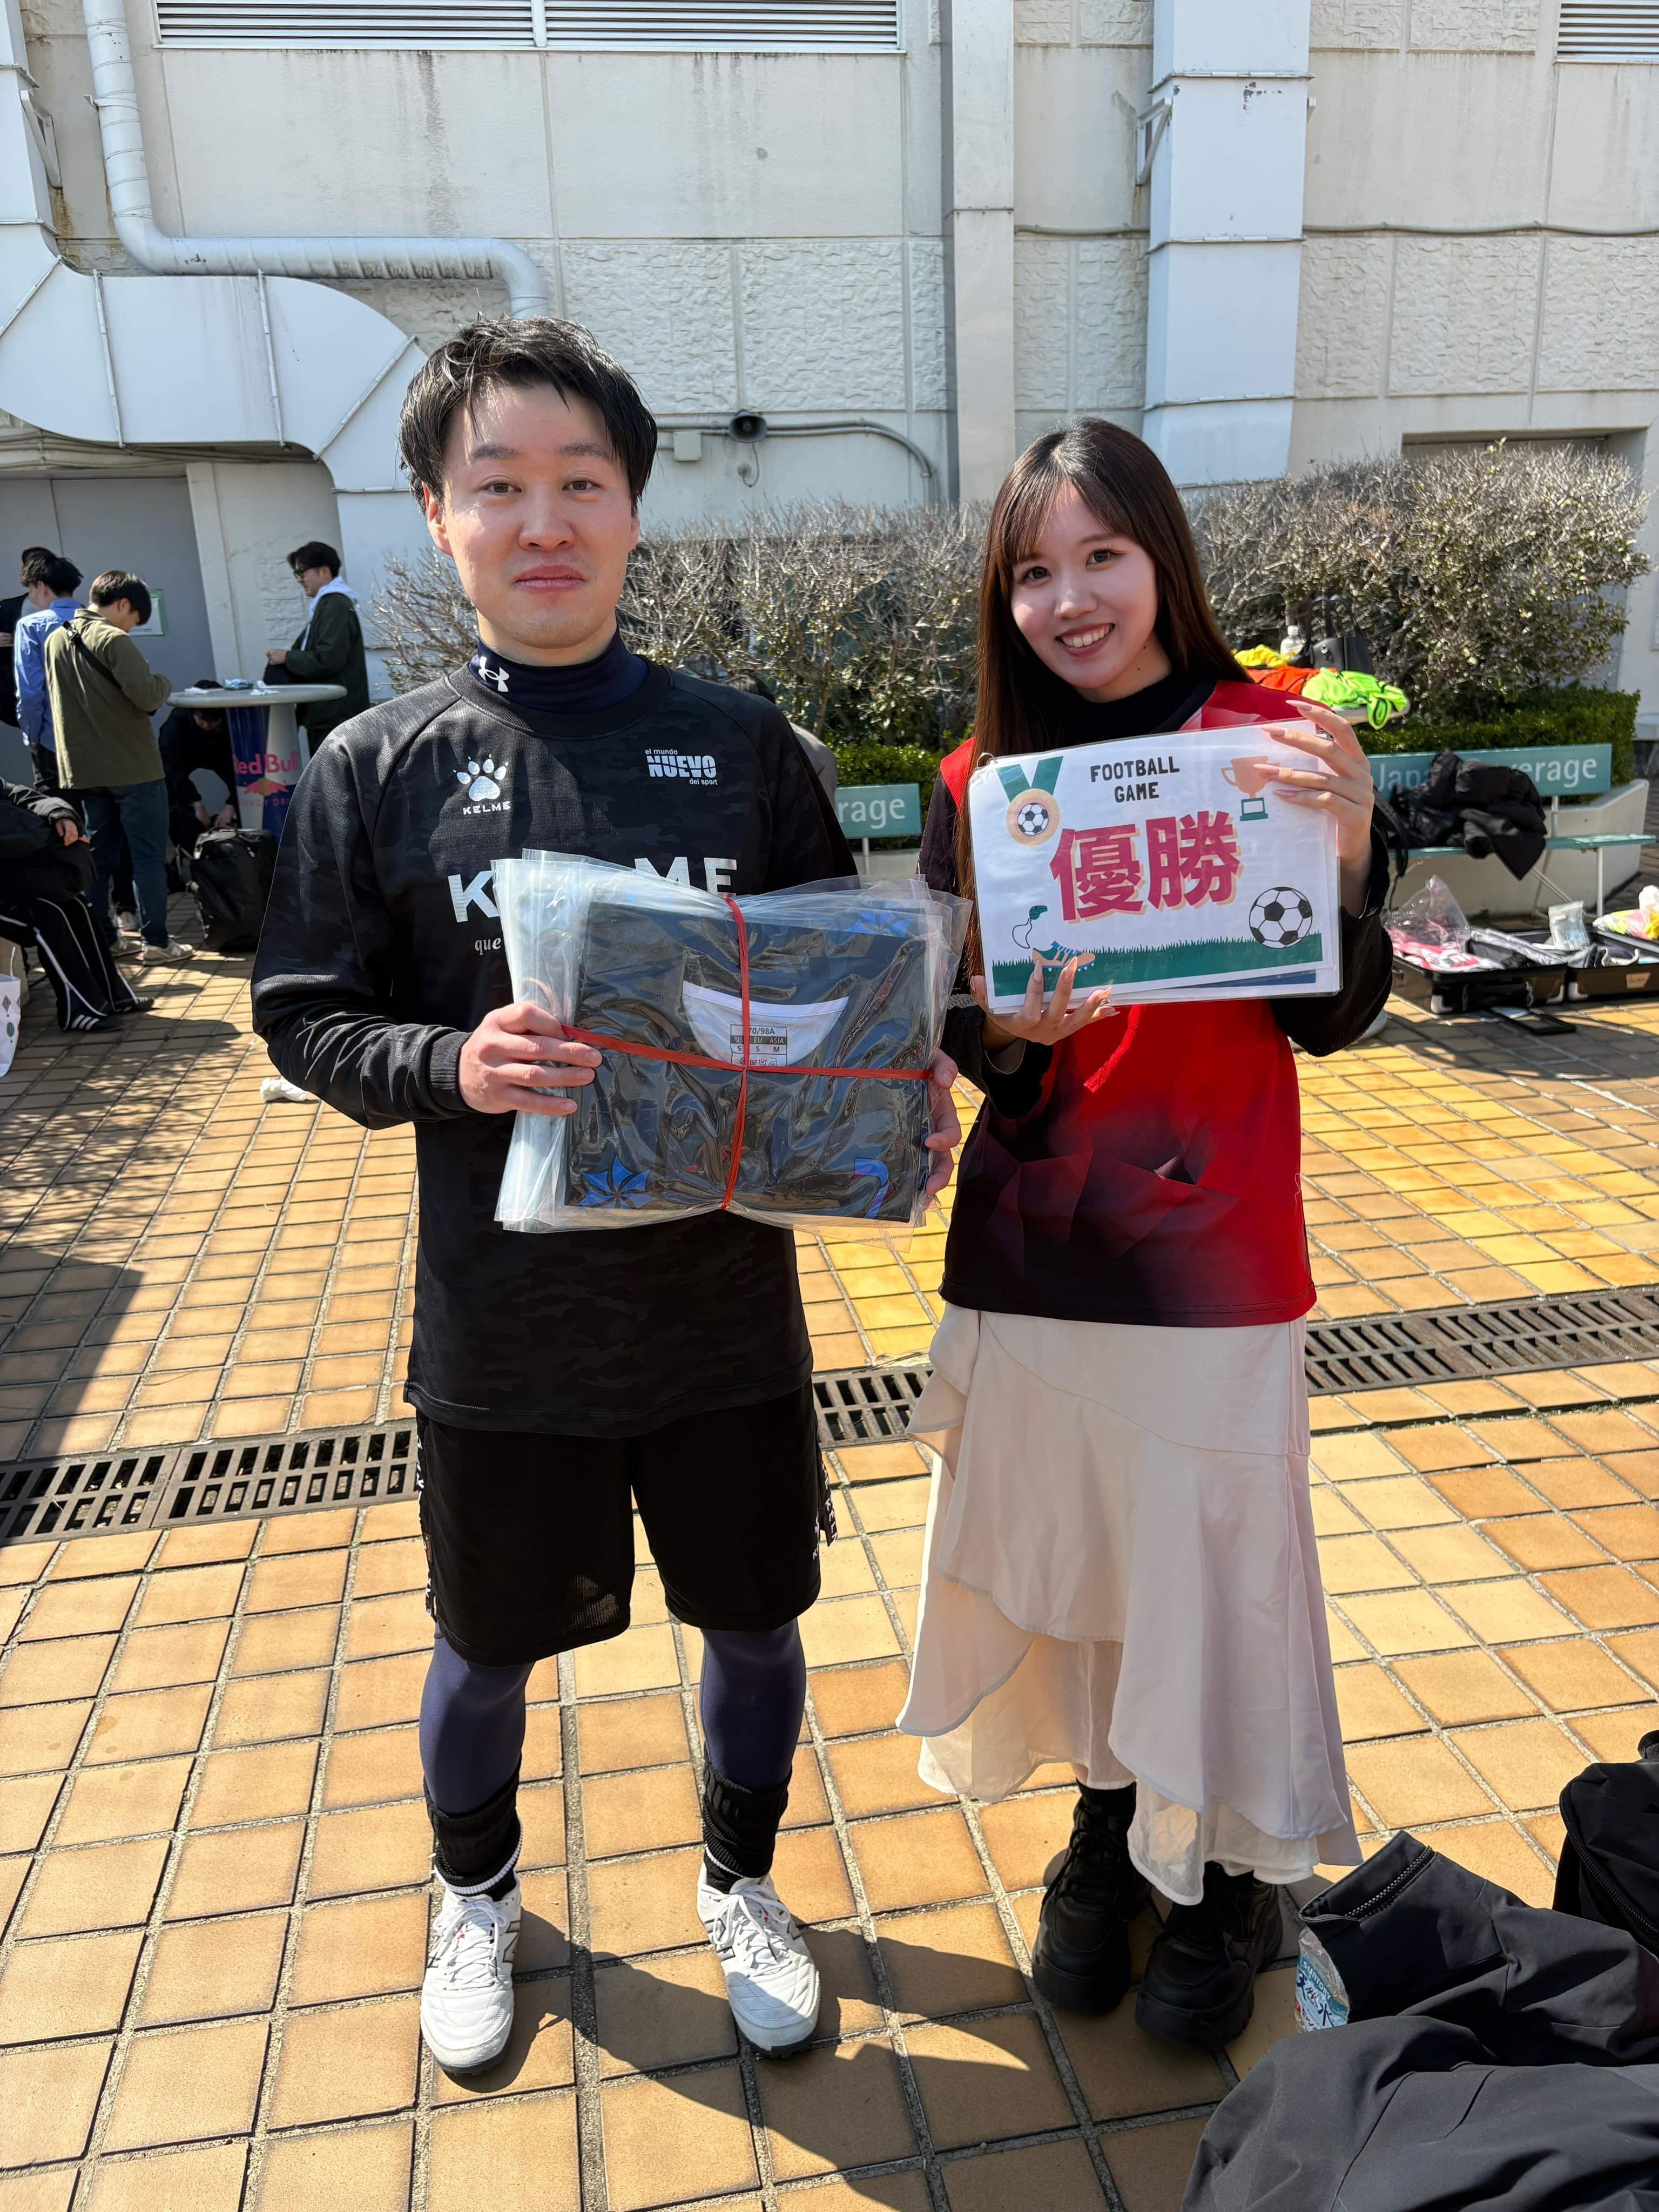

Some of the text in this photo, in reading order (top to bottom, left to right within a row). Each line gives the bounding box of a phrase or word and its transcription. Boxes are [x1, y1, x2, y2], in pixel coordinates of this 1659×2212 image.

[264, 750, 300, 774] Bull
[646, 755, 717, 778] NUEVO
[1090, 756, 1180, 783] FOOTBALL
[1378, 763, 1431, 791] Jap
[1114, 781, 1159, 803] GAME
[462, 800, 511, 815] KELME
[838, 798, 906, 830] rage
[1049, 810, 1243, 923] 優勝
[474, 937, 502, 956] que
[749, 1027, 775, 1035] 70/98A
[1302, 1960, 1332, 2000] SUNTORY
